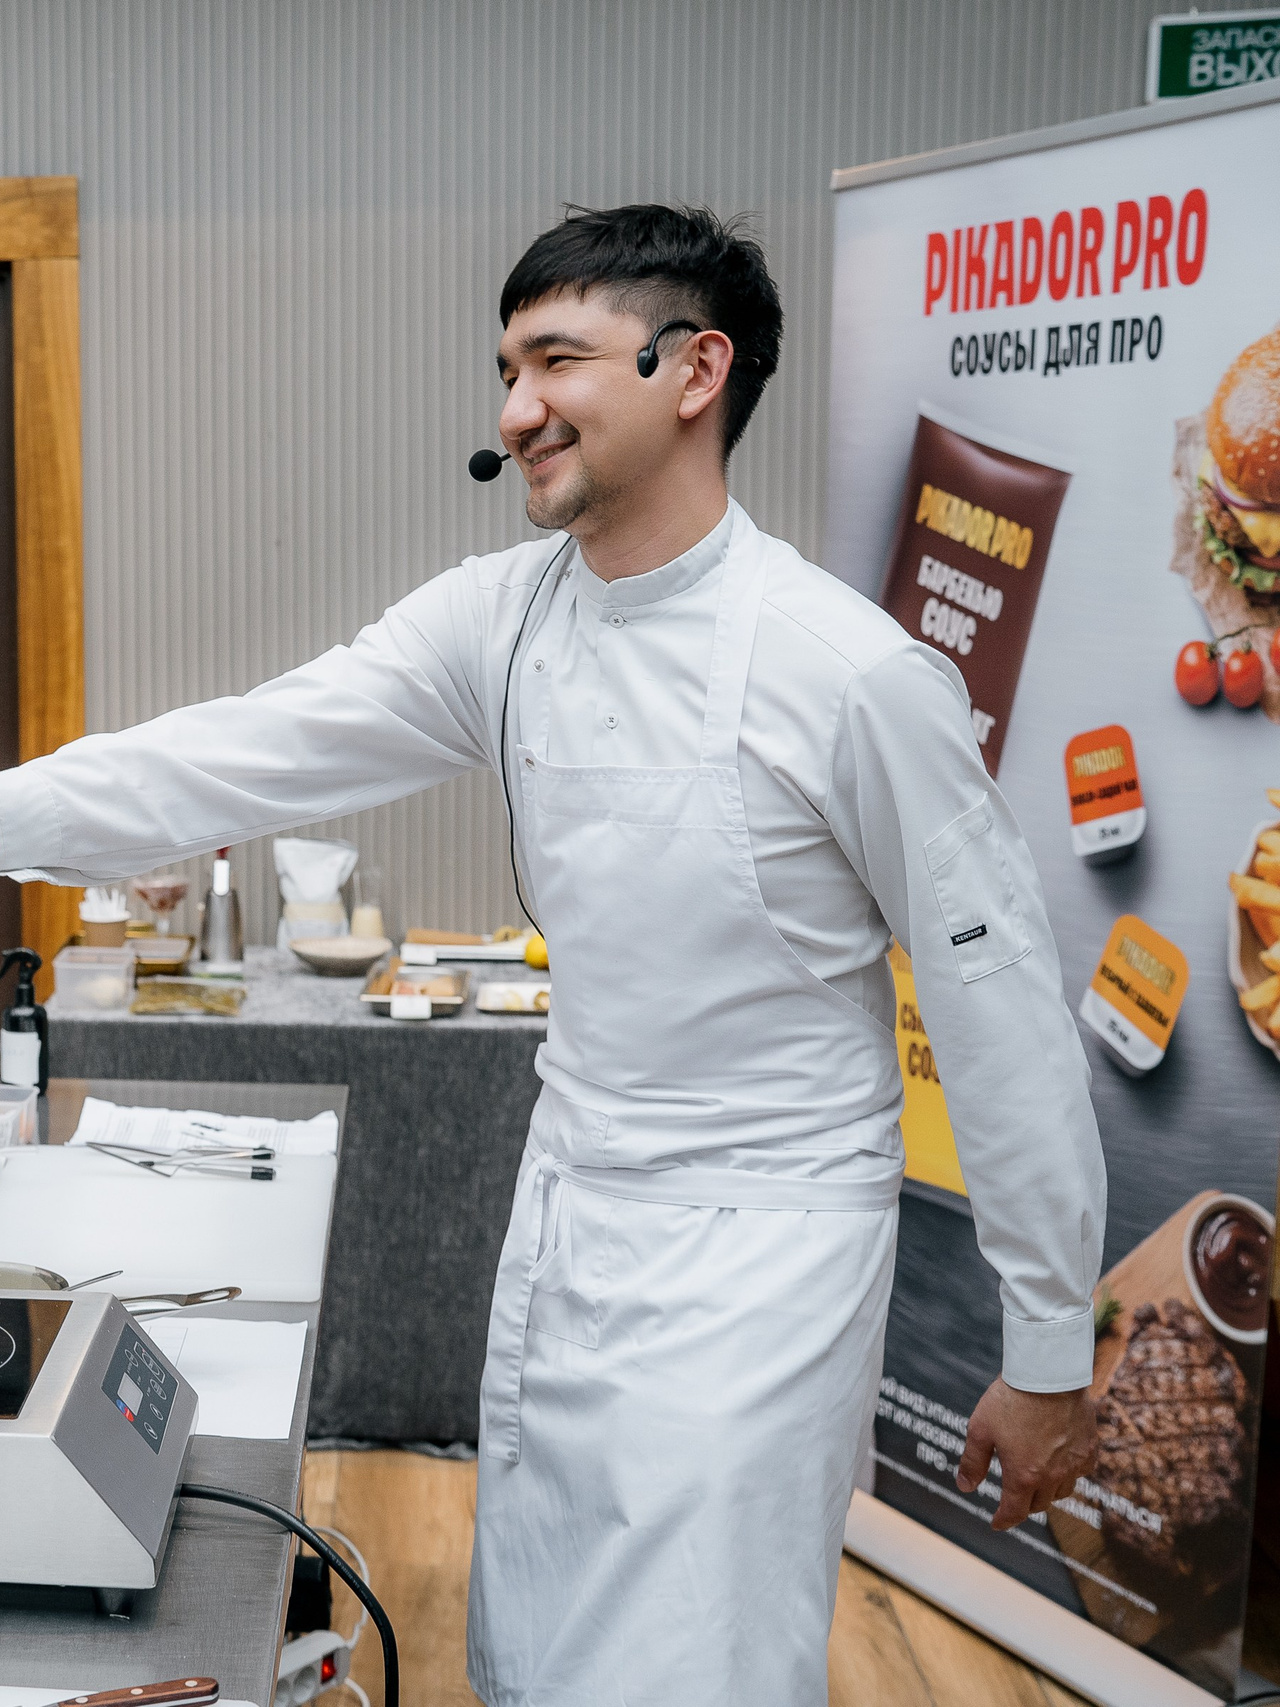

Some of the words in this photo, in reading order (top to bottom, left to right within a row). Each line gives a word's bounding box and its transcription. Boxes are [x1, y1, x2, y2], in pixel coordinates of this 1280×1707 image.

[1192, 25, 1280, 51] ЗАПАС
[923, 207, 1105, 317] PIKADOR
[1111, 187, 1209, 294] PRO
[950, 328, 1036, 378] СОУСЫ
[1042, 321, 1102, 377] ДЛЯ
[1109, 314, 1163, 365] ПРО
[915, 483, 995, 556] PIKADOR
[989, 515, 1034, 570] PRO
[921, 597, 977, 656] СОУС
[954, 927, 983, 943] KENTAUR
